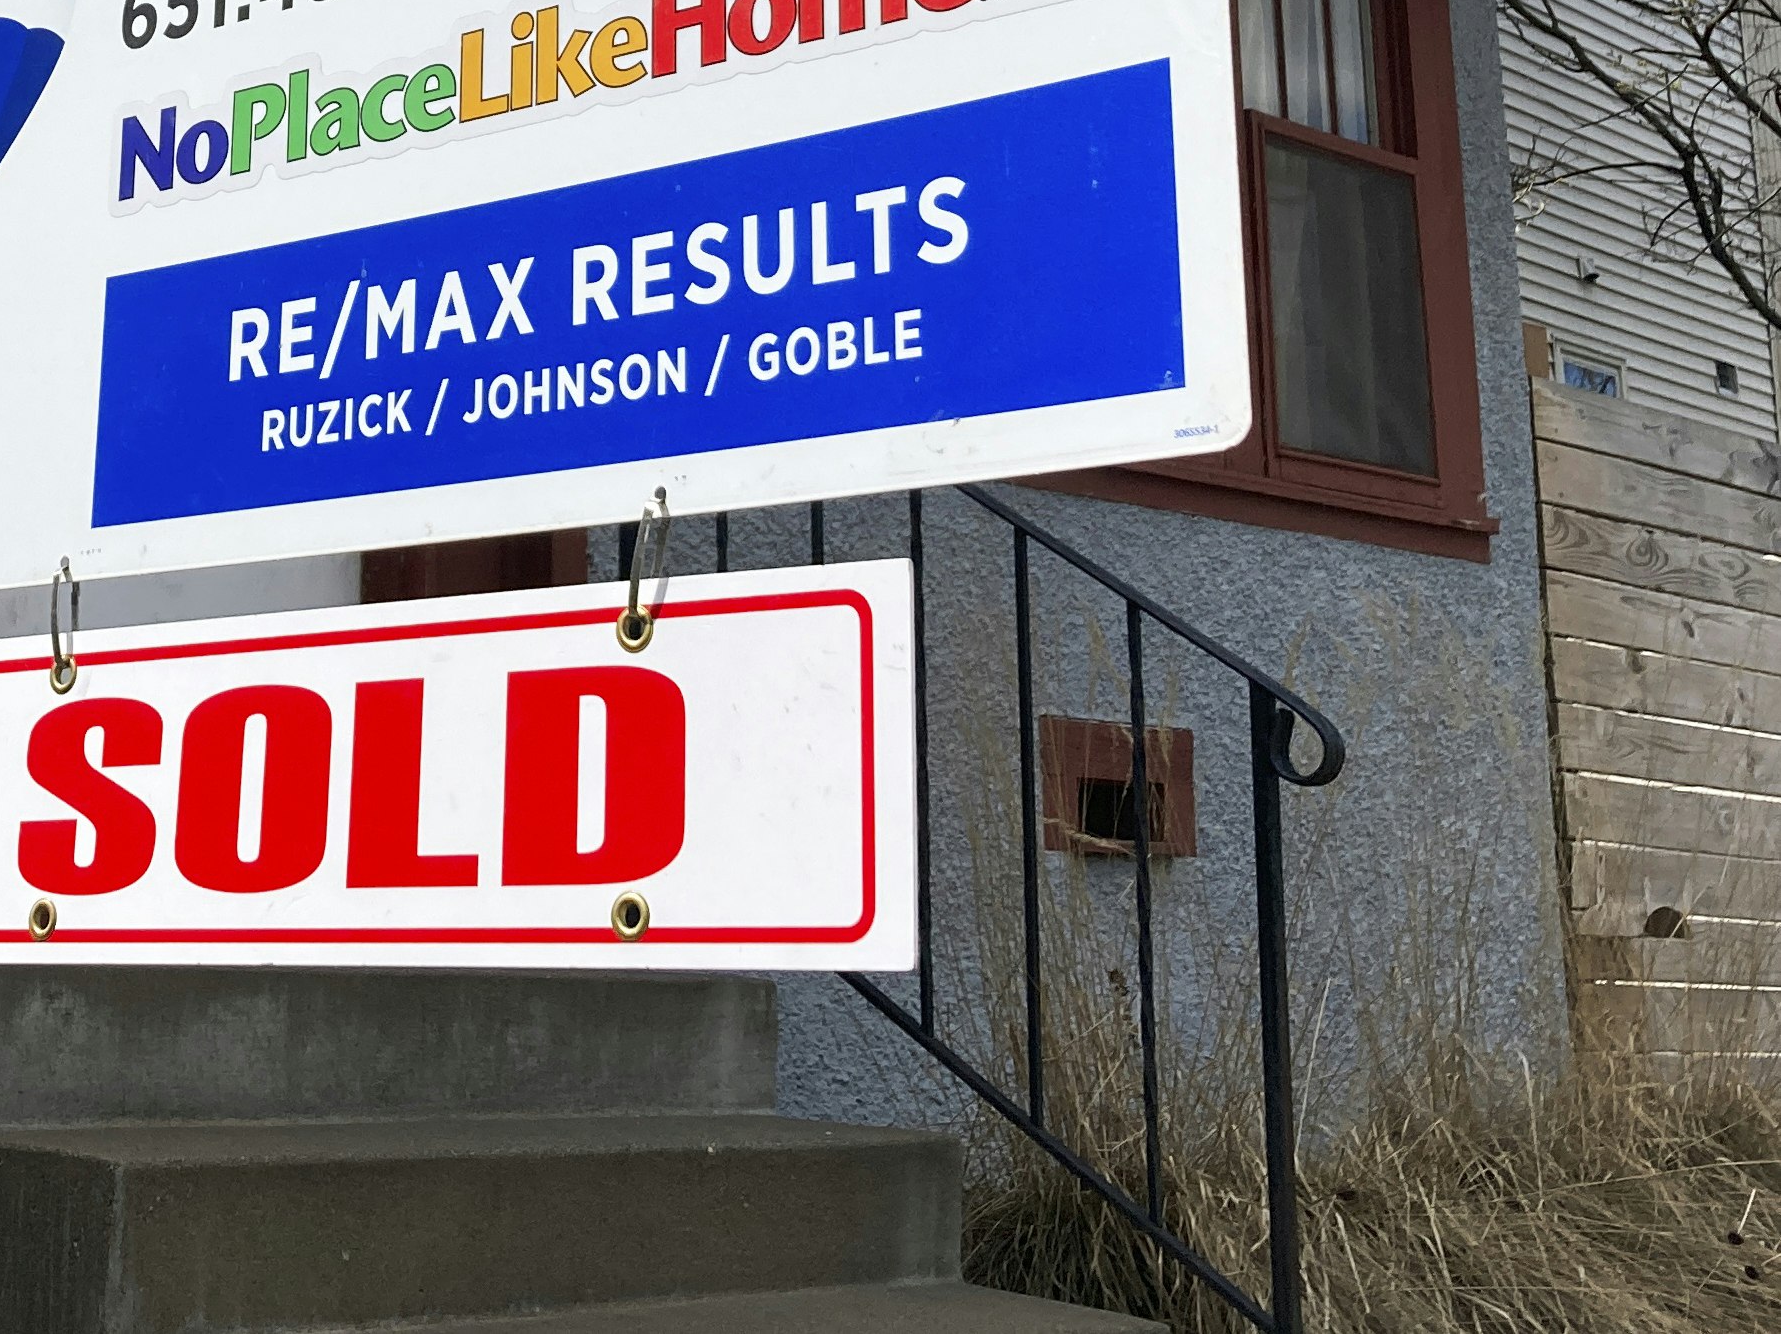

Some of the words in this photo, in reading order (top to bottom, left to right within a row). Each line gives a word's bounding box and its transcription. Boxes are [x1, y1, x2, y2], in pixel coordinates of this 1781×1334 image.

[227, 257, 535, 383] RE/MAX
[571, 175, 971, 327] RESULTS
[261, 388, 412, 452] RUZICK
[425, 378, 447, 436] /
[462, 348, 688, 424] JOHNSON
[704, 334, 729, 397] /
[748, 309, 925, 382] GOBLE
[18, 666, 686, 896] SOLD
